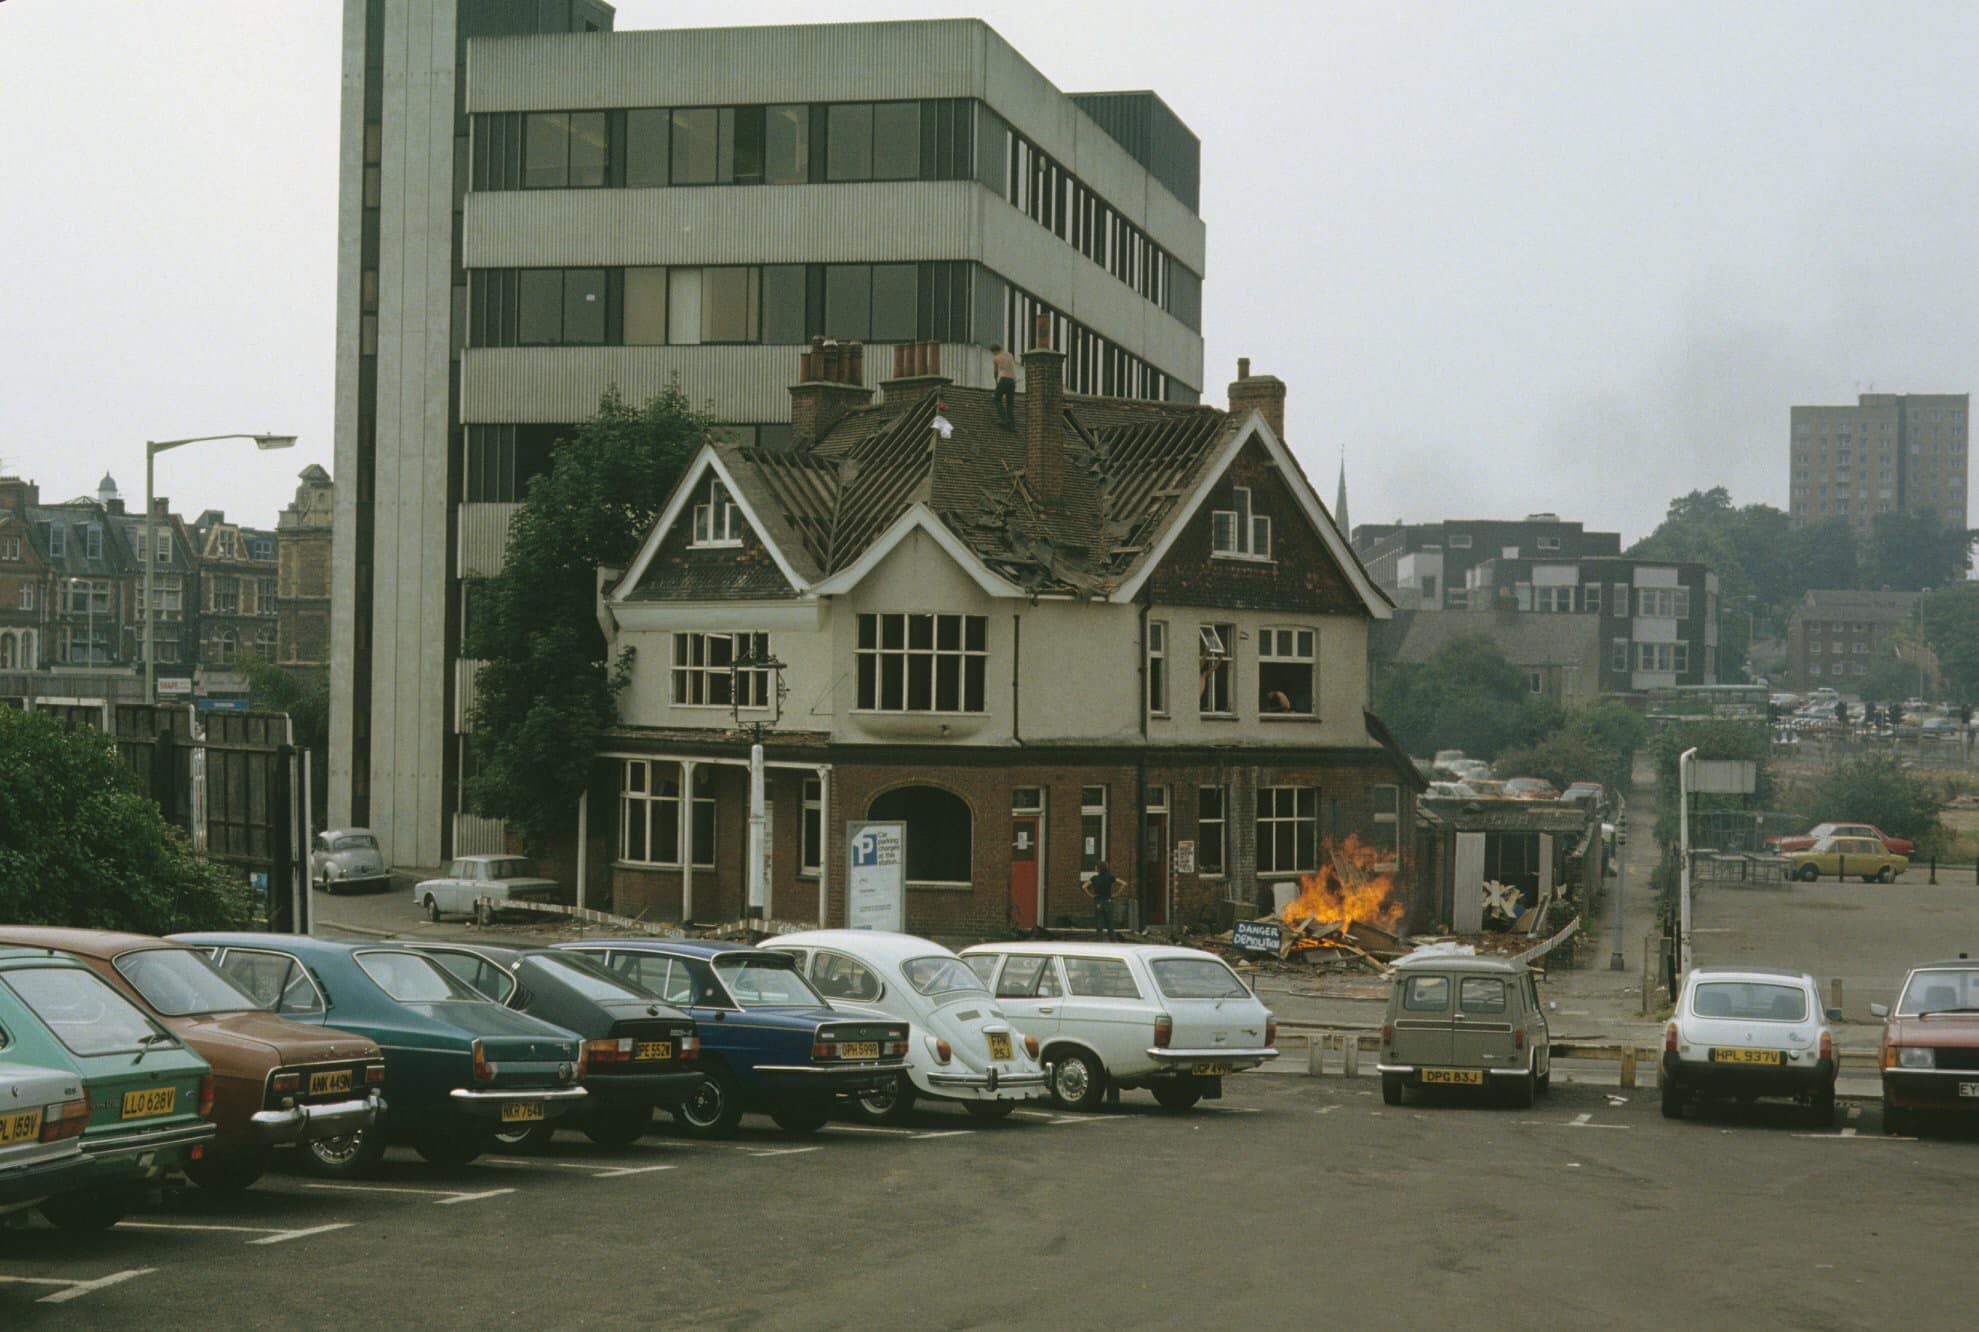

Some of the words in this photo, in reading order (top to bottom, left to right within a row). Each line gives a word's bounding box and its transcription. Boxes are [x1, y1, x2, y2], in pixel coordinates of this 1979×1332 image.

[1238, 923, 1279, 937] DANGER
[1716, 1047, 1741, 1061] HPL
[1743, 1050, 1779, 1063] 937V
[124, 1094, 145, 1114] LLO
[146, 1090, 174, 1112] 628V
